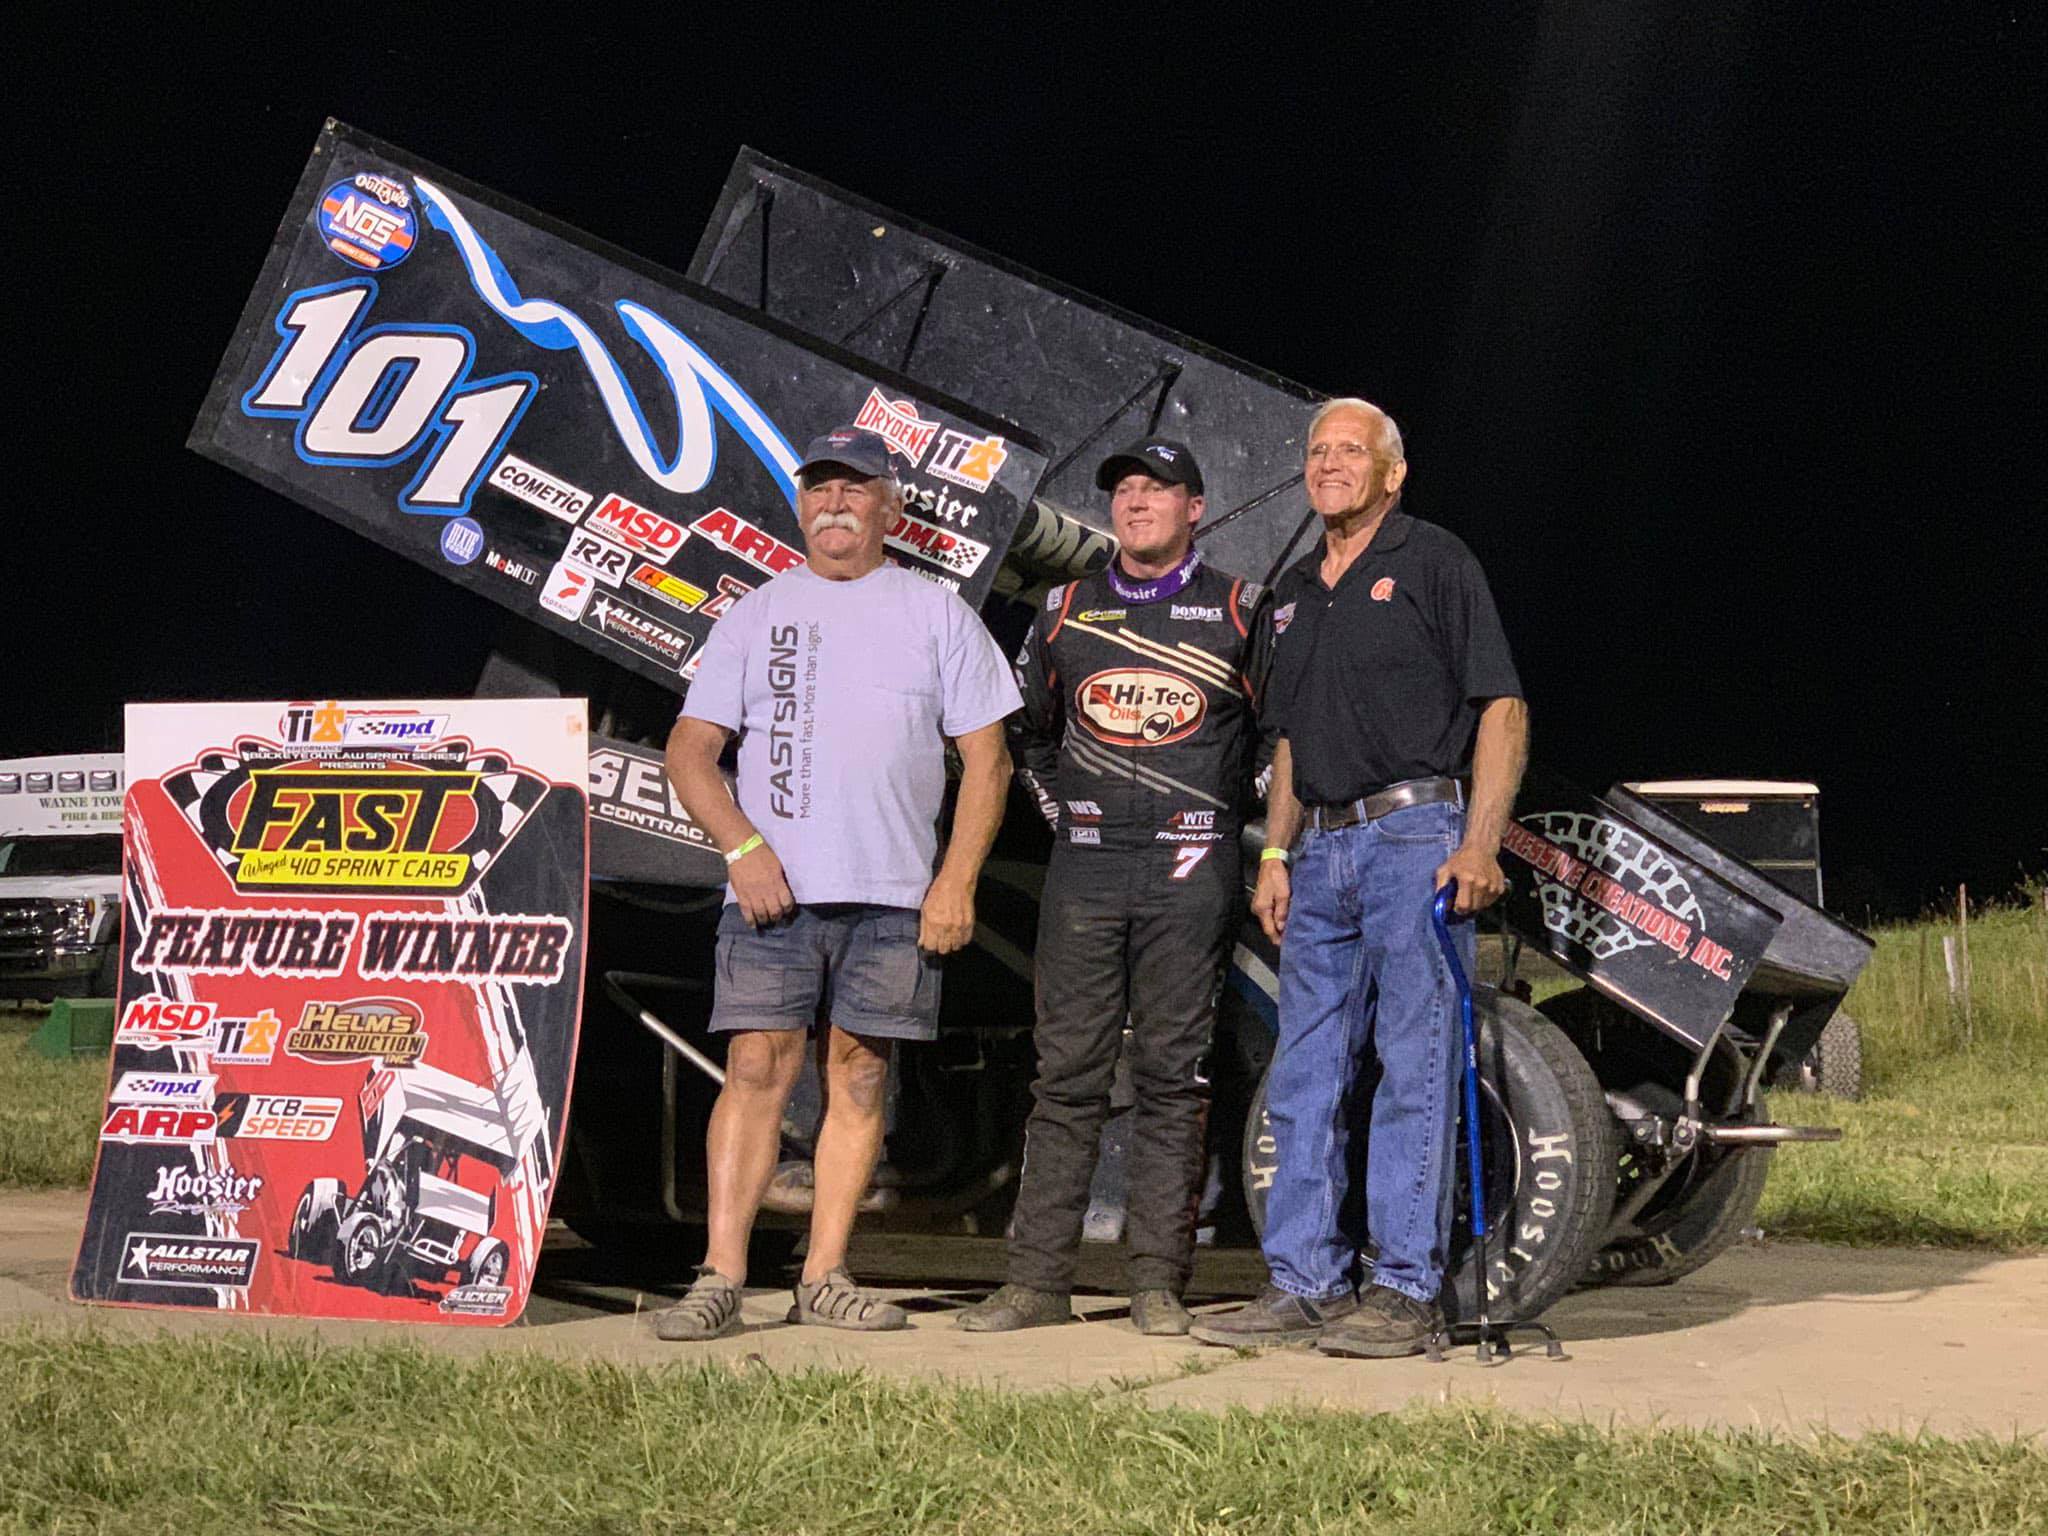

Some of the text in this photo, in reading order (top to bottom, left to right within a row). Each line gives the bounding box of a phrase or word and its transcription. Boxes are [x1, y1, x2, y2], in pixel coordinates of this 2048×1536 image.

[333, 195, 406, 245] NOS
[246, 280, 537, 511] 101
[856, 395, 935, 459] DRYDENE
[928, 467, 986, 492] PERFORMANCE
[898, 483, 978, 528] osier
[597, 497, 681, 549] MSD
[890, 515, 957, 552] MP
[485, 550, 522, 579] Mobil
[920, 545, 965, 569] CAMS
[1114, 579, 1158, 600] Hoosier
[607, 620, 680, 660] PERFORMANCE
[609, 607, 686, 649] ALLSTAR
[804, 655, 817, 681] than
[803, 685, 817, 714] More
[1115, 684, 1196, 706] Hi-Tec
[383, 719, 435, 738] mpd
[768, 624, 799, 820] FASTSIGNS
[250, 751, 457, 761] BUCKEYE OUTLAW SPRINT SERIES
[319, 762, 387, 770] PRESENTS
[801, 747, 813, 778] than
[589, 753, 692, 822] SE
[800, 783, 812, 819] More
[39, 796, 124, 809] WAYNE TOW
[61, 812, 88, 821] FIRE
[232, 770, 480, 853] FAST
[600, 802, 712, 844] CONTRAC
[243, 855, 461, 879] Winged 410 SPRINT CARS
[1172, 847, 1209, 878] 7
[1503, 818, 1735, 982] RESSIVE CREATIONS, INC.
[135, 914, 567, 980] FEATURE WINNER
[124, 1003, 211, 1032] MSD
[301, 1004, 414, 1034] HELMS
[288, 1030, 423, 1053] CONSTRUCTION
[213, 1056, 270, 1064] PERFORMANCE
[384, 1054, 411, 1065] INC
[151, 1078, 202, 1096] mpd
[255, 1097, 302, 1116] TCB
[102, 1109, 216, 1138] ARP
[243, 1116, 326, 1137] SPEED
[147, 1165, 263, 1201] Hoosier
[150, 1244, 250, 1262] ALLSTAR
[148, 1261, 246, 1276] PERFORMANCE
[451, 1290, 507, 1304] SLICKER
